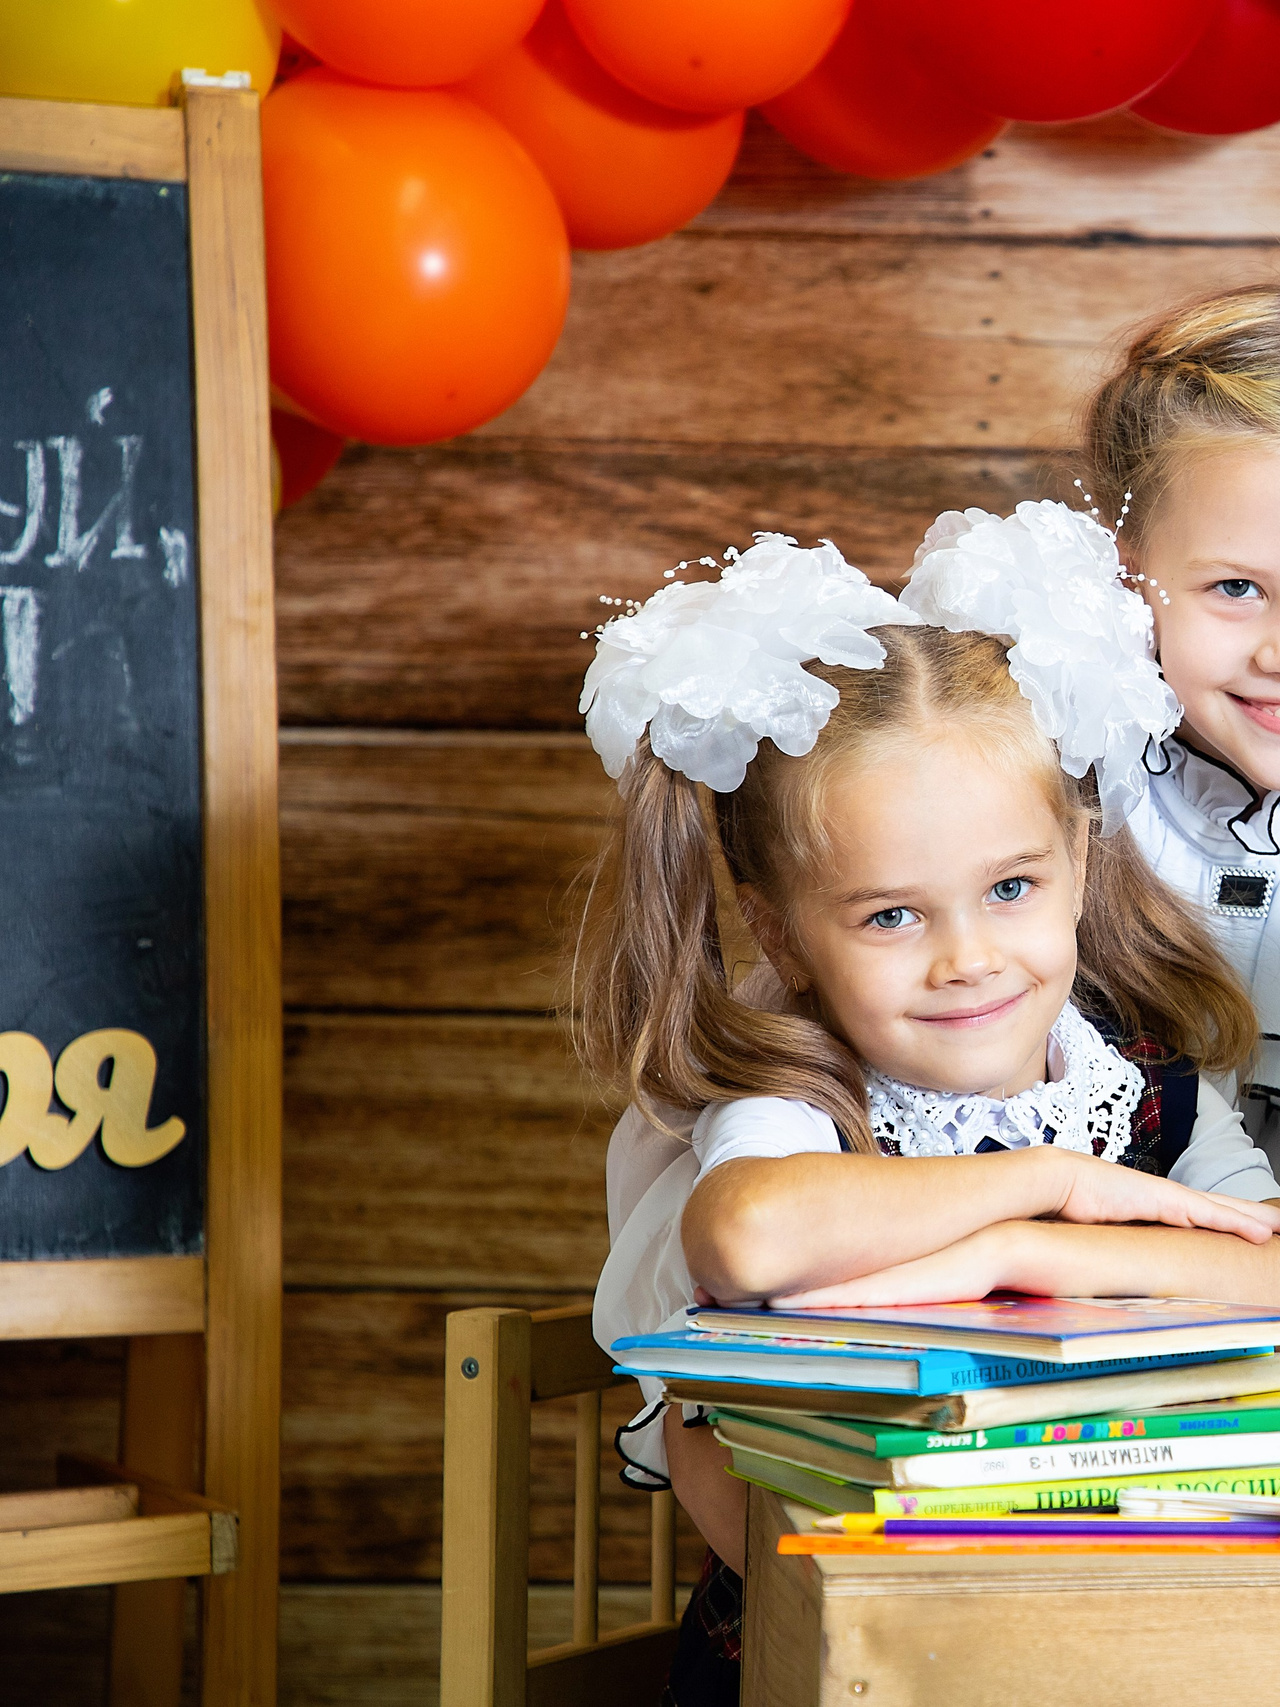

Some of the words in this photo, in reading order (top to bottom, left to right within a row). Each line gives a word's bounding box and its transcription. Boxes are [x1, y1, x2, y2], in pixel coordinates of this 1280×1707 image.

[951, 1361, 1012, 1387] ЧТЕНИЯ
[926, 1432, 974, 1449] КЛАСС
[1069, 1445, 1174, 1469] МАТЕМАТИКА
[924, 1500, 1020, 1516] ОПРЕДЕЛИТЕЛЬ
